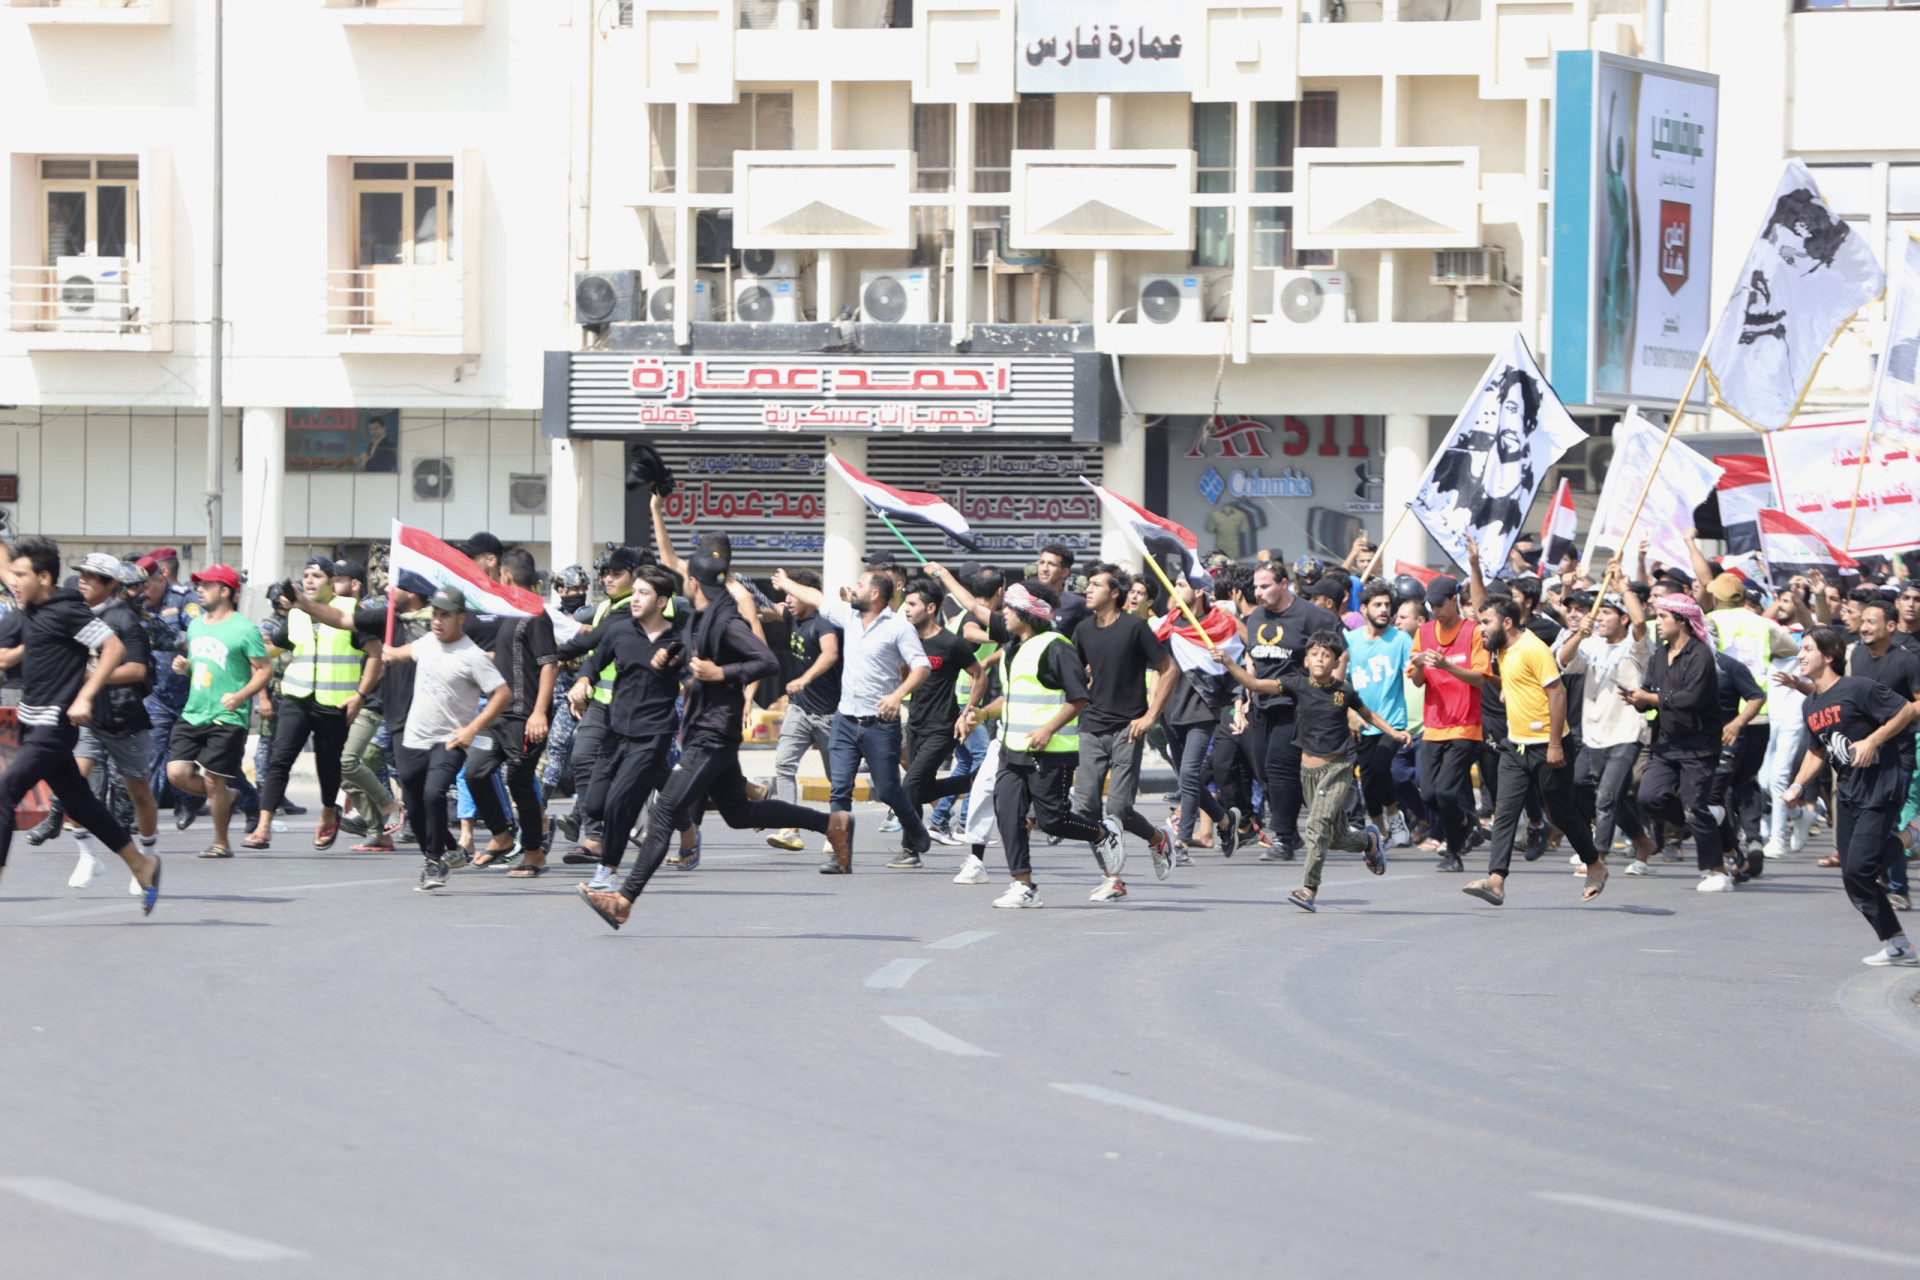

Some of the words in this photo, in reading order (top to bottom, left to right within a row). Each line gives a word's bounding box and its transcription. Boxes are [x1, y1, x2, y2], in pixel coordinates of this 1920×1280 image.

[1026, 24, 1101, 66] فارس
[1109, 25, 1183, 65] عمارة
[632, 359, 818, 398] عمارة
[835, 368, 1006, 391] احمد
[641, 400, 695, 431] جملة
[765, 403, 869, 430] عسكرية
[879, 402, 989, 431] تجهيزات
[688, 453, 743, 473] الهودج
[749, 454, 782, 472] سما
[788, 455, 825, 475] ركة
[939, 457, 993, 476] الهودج
[998, 455, 1032, 473] سما
[1036, 453, 1087, 476] شركة
[1228, 468, 1313, 497] Columbia
[767, 532, 825, 552] جهيزات
